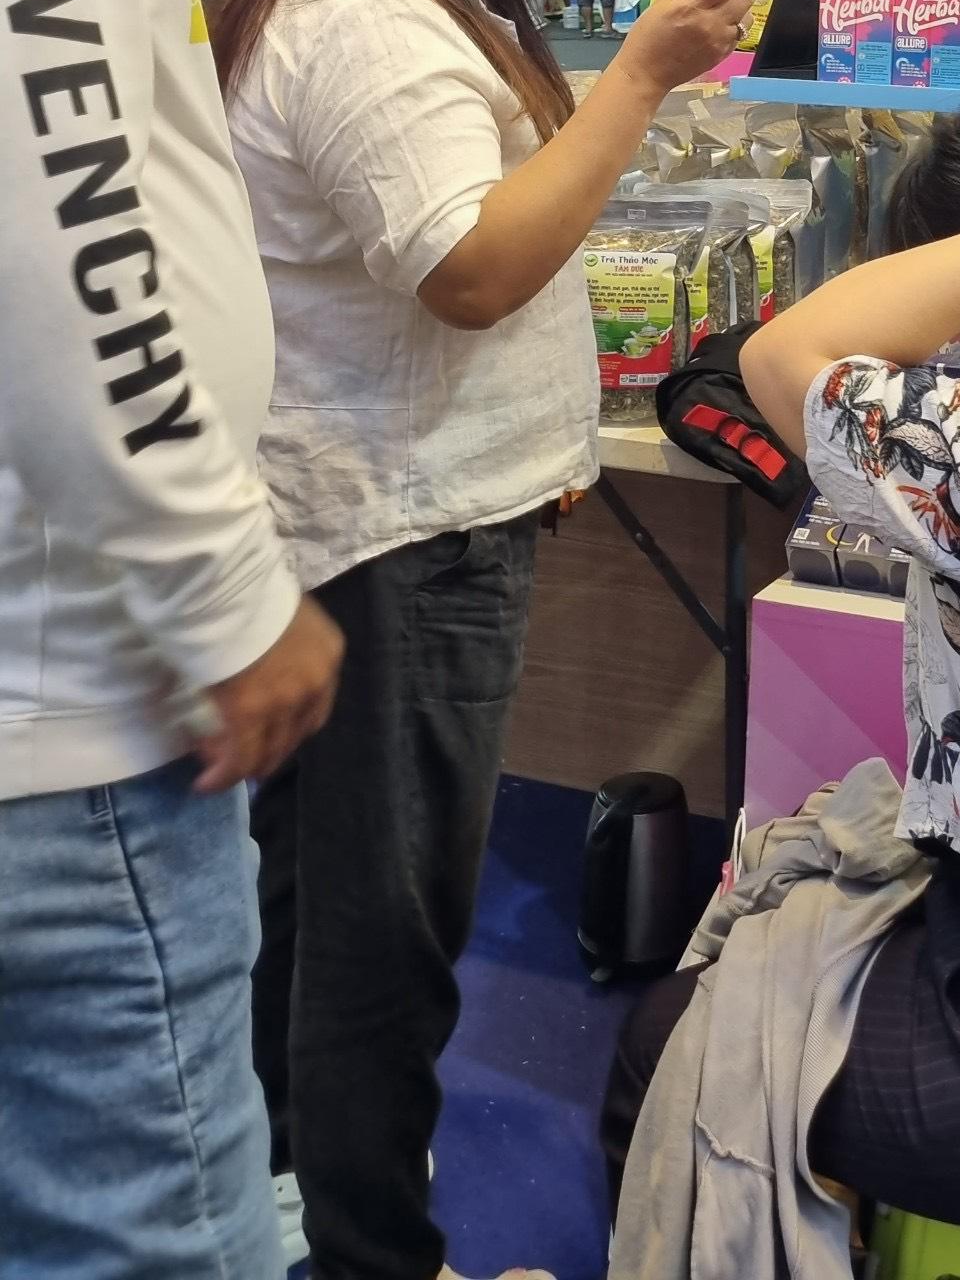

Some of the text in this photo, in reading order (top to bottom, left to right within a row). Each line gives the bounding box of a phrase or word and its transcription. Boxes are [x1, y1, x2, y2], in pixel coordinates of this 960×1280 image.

[600, 255, 659, 265] Trà Thảo Mộc
